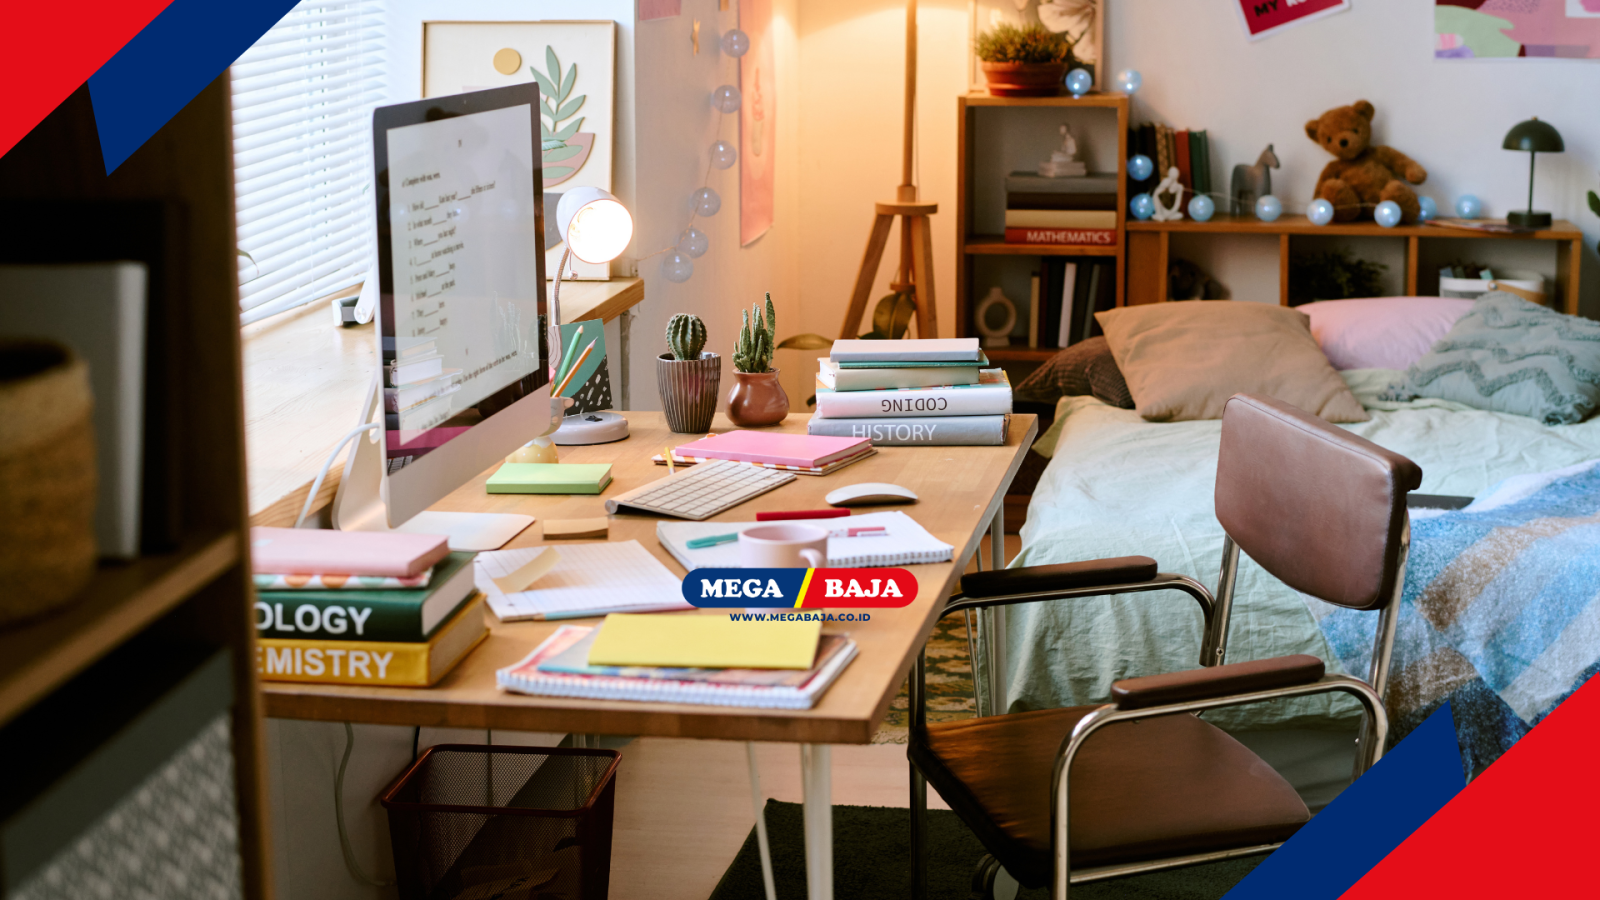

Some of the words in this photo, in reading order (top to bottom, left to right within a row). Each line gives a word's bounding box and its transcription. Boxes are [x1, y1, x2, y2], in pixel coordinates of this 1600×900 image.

[1254, 0, 1277, 17] MY
[1026, 231, 1111, 244] MATHEMATICS
[881, 397, 947, 413] CODING
[852, 424, 937, 441] HISTORY
